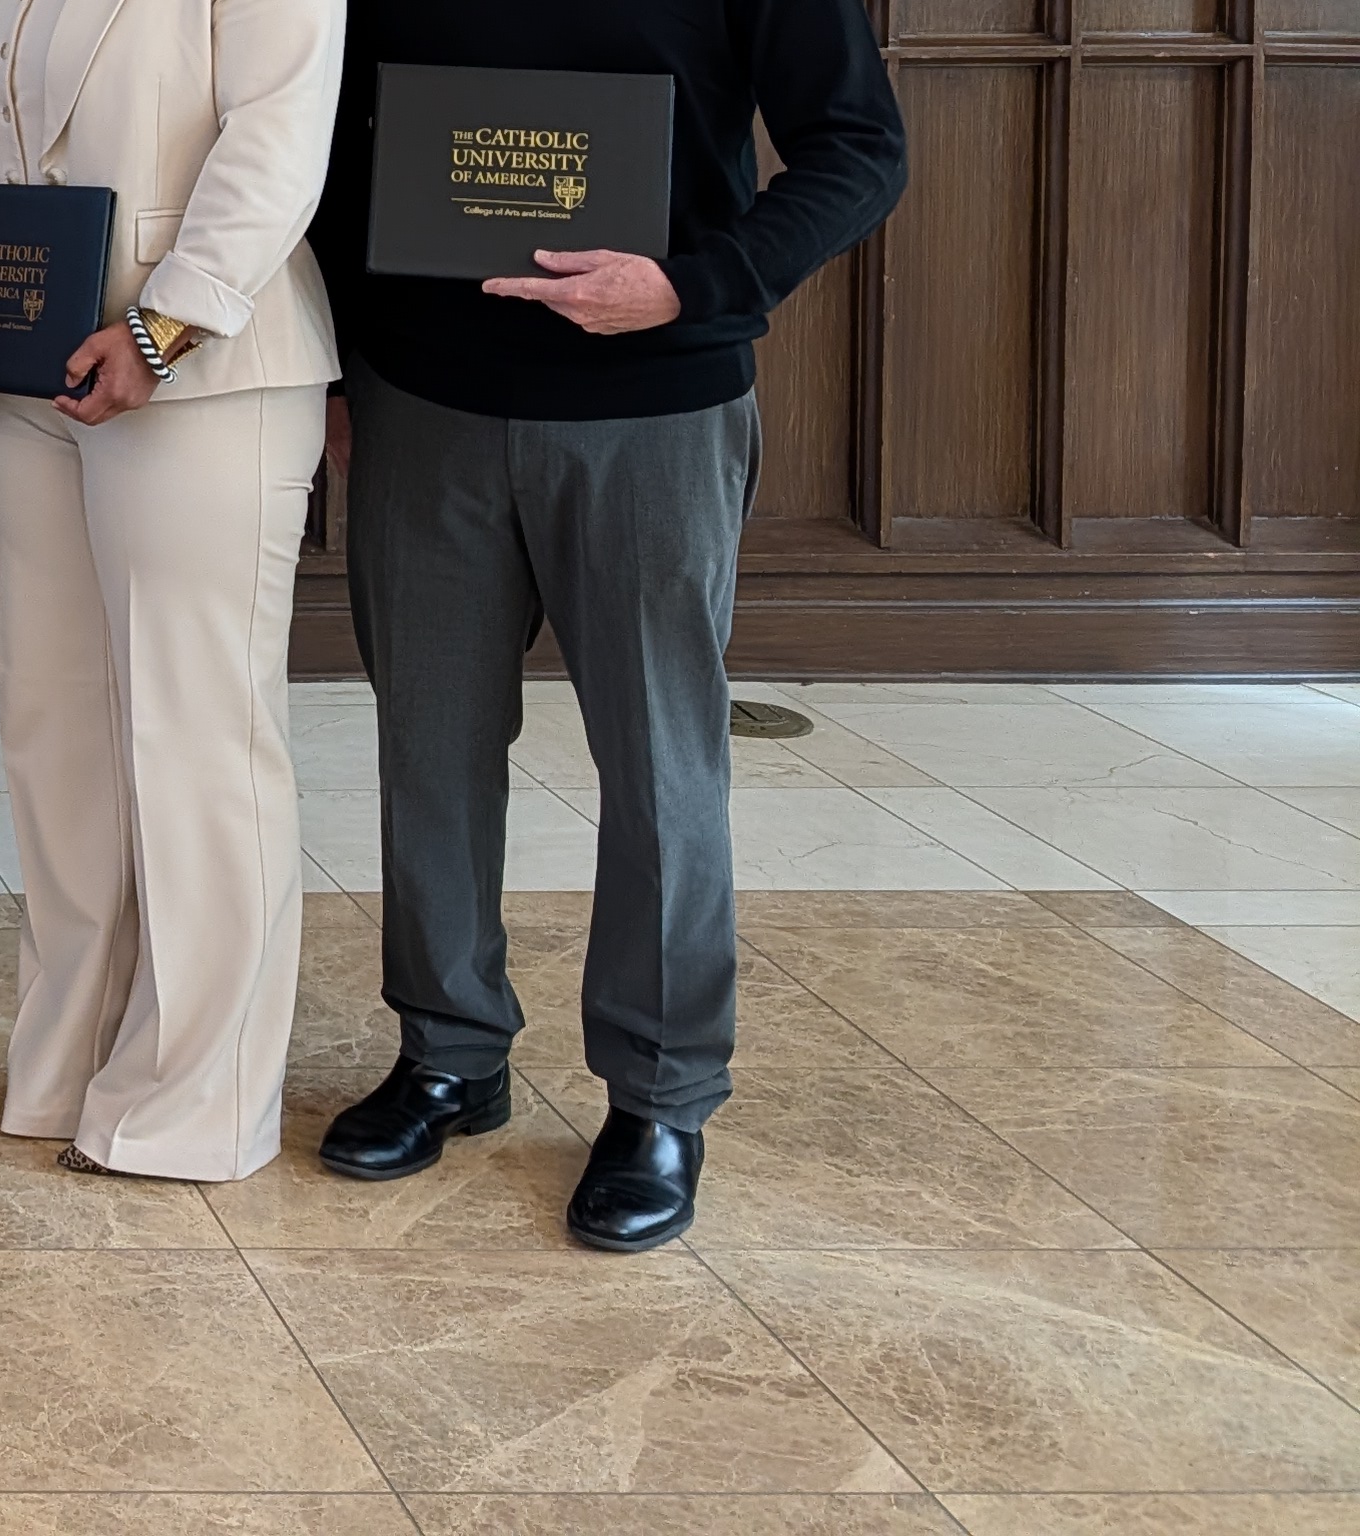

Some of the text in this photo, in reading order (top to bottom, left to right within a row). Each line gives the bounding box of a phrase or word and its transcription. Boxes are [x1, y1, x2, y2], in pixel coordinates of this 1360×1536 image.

[452, 127, 589, 150] THE CATHOLIC
[452, 148, 588, 172] UNIVERSITY
[450, 169, 547, 187] OF AMERICA
[463, 205, 493, 217] College
[504, 208, 520, 217] Arts
[521, 209, 537, 218] and
[537, 210, 572, 220] Sciences
